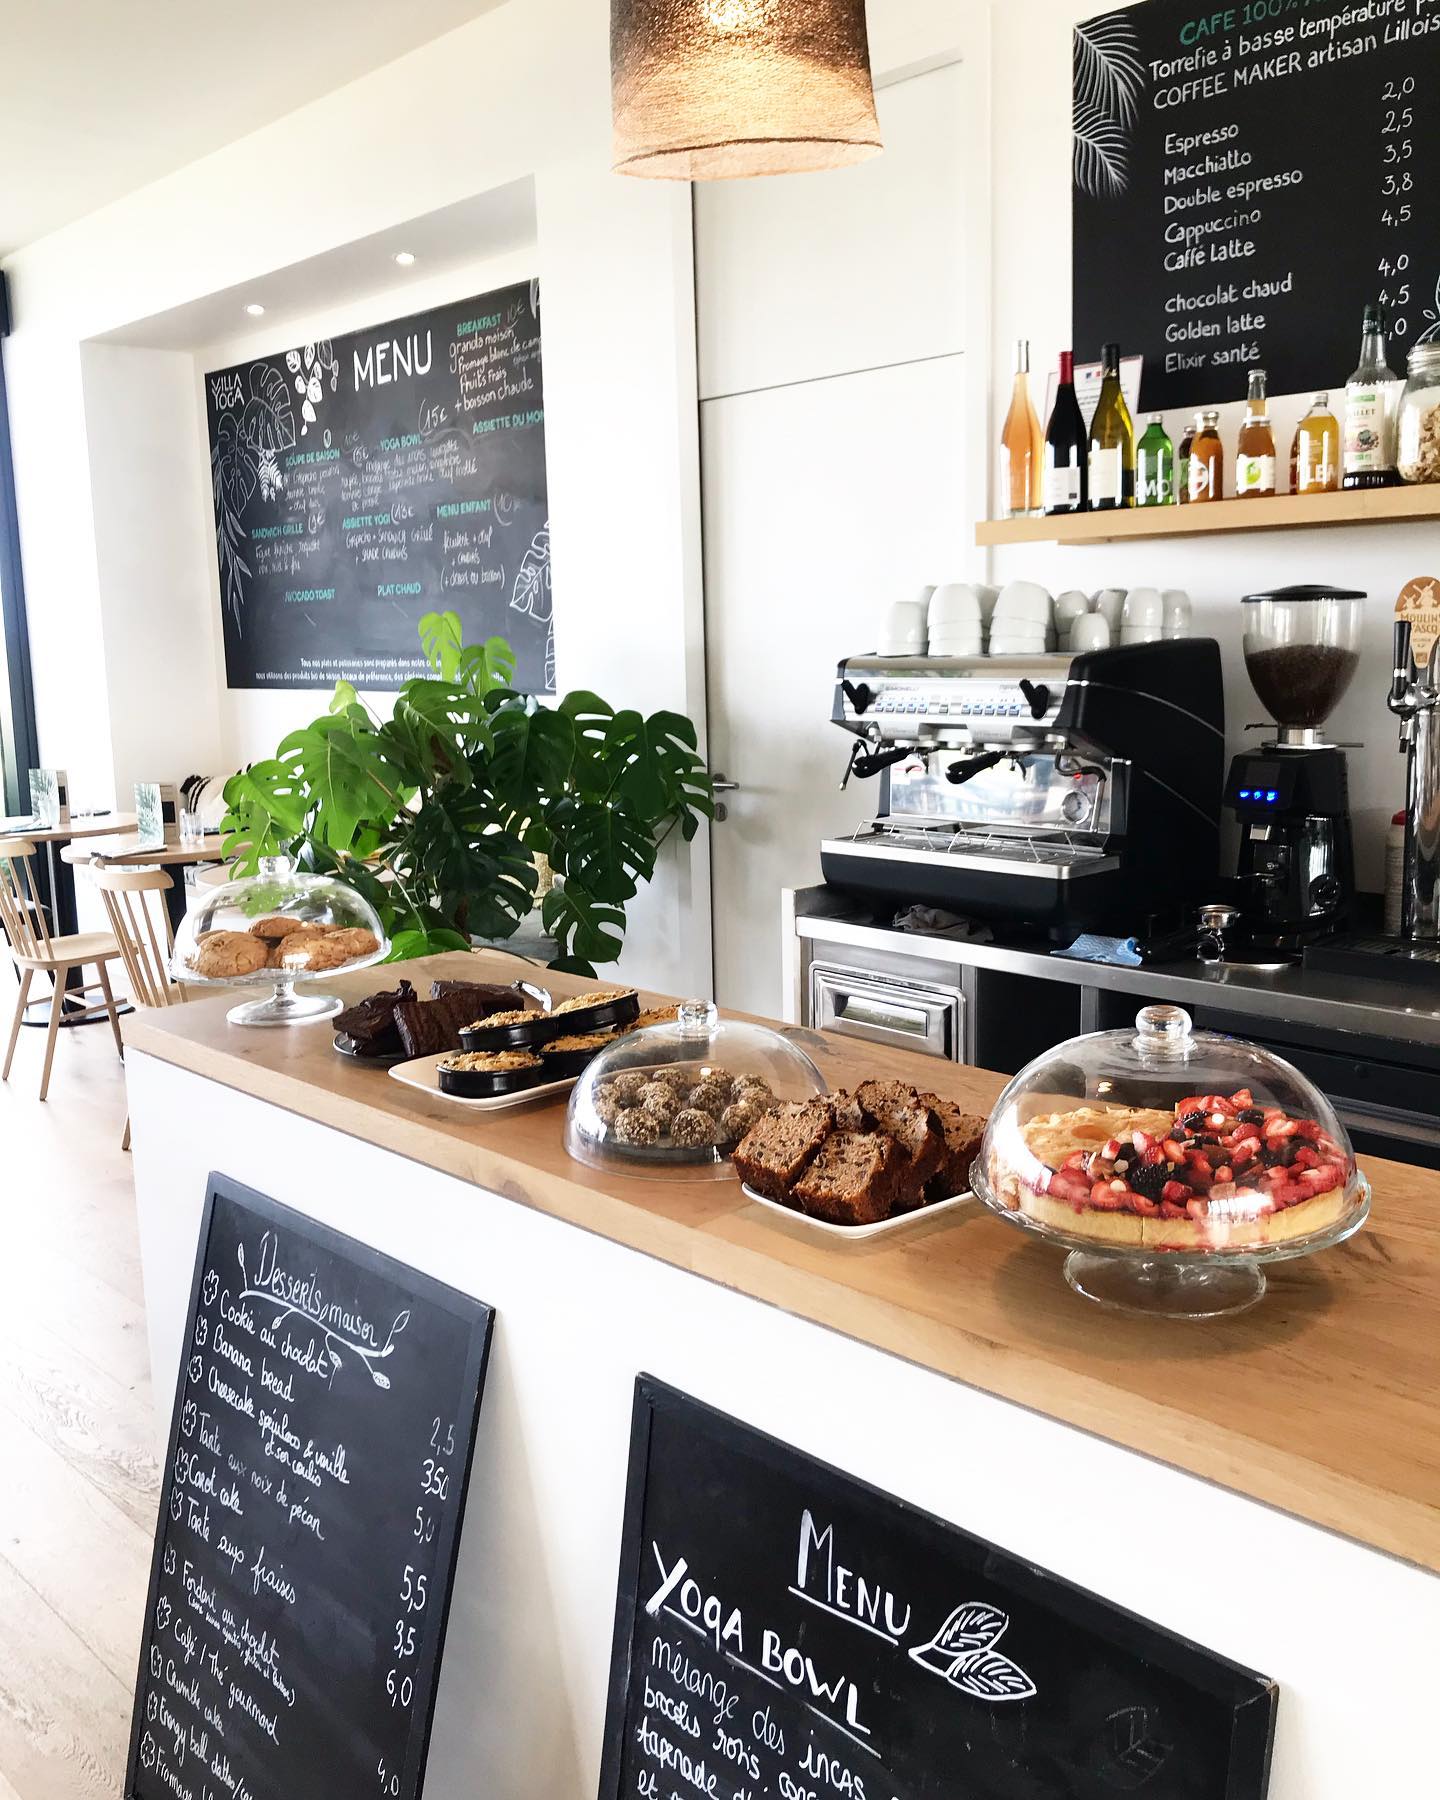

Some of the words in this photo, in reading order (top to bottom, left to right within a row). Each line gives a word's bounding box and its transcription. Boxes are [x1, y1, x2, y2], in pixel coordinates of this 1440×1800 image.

[1178, 8, 1236, 46] CAFE
[1239, 26, 1295, 57] basse
[1299, 0, 1406, 40] température
[1153, 72, 1228, 110] COFFEE
[1233, 52, 1302, 88] MAKER
[1307, 34, 1377, 68] artisan
[1384, 13, 1440, 44] Lillois
[1382, 76, 1415, 101] 2,0
[1164, 123, 1239, 155] Espresso
[1381, 108, 1413, 134] 2,5
[1382, 139, 1412, 164] 3,5
[1164, 186, 1223, 214] Double
[1226, 169, 1304, 200] espresso
[1381, 172, 1413, 196] 3,8
[1164, 209, 1262, 248] Cappuccino
[1381, 204, 1412, 227] 4,5
[1378, 254, 1409, 277] 4,0
[1242, 272, 1293, 300] chaud
[1378, 284, 1410, 308] 4,5
[457, 313, 502, 336] BREAKFAST
[485, 328, 515, 345] maison
[1165, 320, 1221, 343] Golden
[1227, 313, 1266, 334] latte
[353, 329, 433, 392] MENU
[1165, 350, 1205, 373] Elixir
[1210, 341, 1261, 366] santé
[211, 372, 242, 392] VILLA
[211, 386, 245, 411] YOGA
[463, 390, 496, 411] boisson
[497, 366, 534, 401] chaude
[380, 438, 400, 450] YOGA
[401, 434, 422, 448] BOWL
[473, 416, 511, 434] ASSIETTE
[512, 411, 525, 426] DU
[306, 453, 315, 463] DE
[316, 448, 340, 461] SAISON
[342, 515, 373, 530] ASSIETTE
[374, 513, 391, 525] YOGI
[436, 502, 460, 518] MENU
[460, 499, 492, 514] ENFANT
[252, 526, 282, 539] SANDWICH
[285, 590, 315, 602] AVOCADO
[315, 588, 336, 600] TOAST
[377, 584, 395, 597] PLAT
[395, 582, 421, 595] CHAUD
[220, 1289, 256, 1335] Cookie
[260, 1326, 276, 1348] au
[281, 1332, 328, 1378] chocolat
[329, 1302, 378, 1347] maison
[213, 1323, 254, 1377] Banana
[260, 1357, 294, 1402] bread
[208, 1365, 255, 1418] Cheesecake
[315, 1443, 350, 1485] vanille
[199, 1411, 222, 1457] Tarte
[227, 1453, 247, 1477] aux
[251, 1471, 273, 1495] noix
[276, 1479, 288, 1507] de
[288, 1496, 325, 1541] pécan
[430, 1416, 455, 1456] 2,5
[219, 1482, 243, 1516] cake
[420, 1458, 450, 1500] 3,50
[291, 1459, 322, 1487] coulis
[187, 1495, 210, 1542] Tarte
[250, 1545, 296, 1604] fraises
[413, 1505, 435, 1544] 5,0
[797, 1508, 911, 1635] MENU
[183, 1560, 217, 1613] Fondant
[222, 1608, 236, 1628] au
[399, 1564, 427, 1613] 5,5
[174, 1617, 198, 1664] Café
[208, 1649, 229, 1686] Thé
[228, 1682, 280, 1746] gourmand
[393, 1619, 417, 1659] 3,5
[652, 1636, 740, 1725] mélange
[752, 1705, 785, 1756] des
[761, 1628, 871, 1735] BOWL
[204, 1703, 225, 1737] cake
[385, 1669, 413, 1708] 6,0
[160, 1695, 187, 1768] Energy
[189, 1724, 208, 1763] ball
[377, 1757, 400, 1796] 4,0
